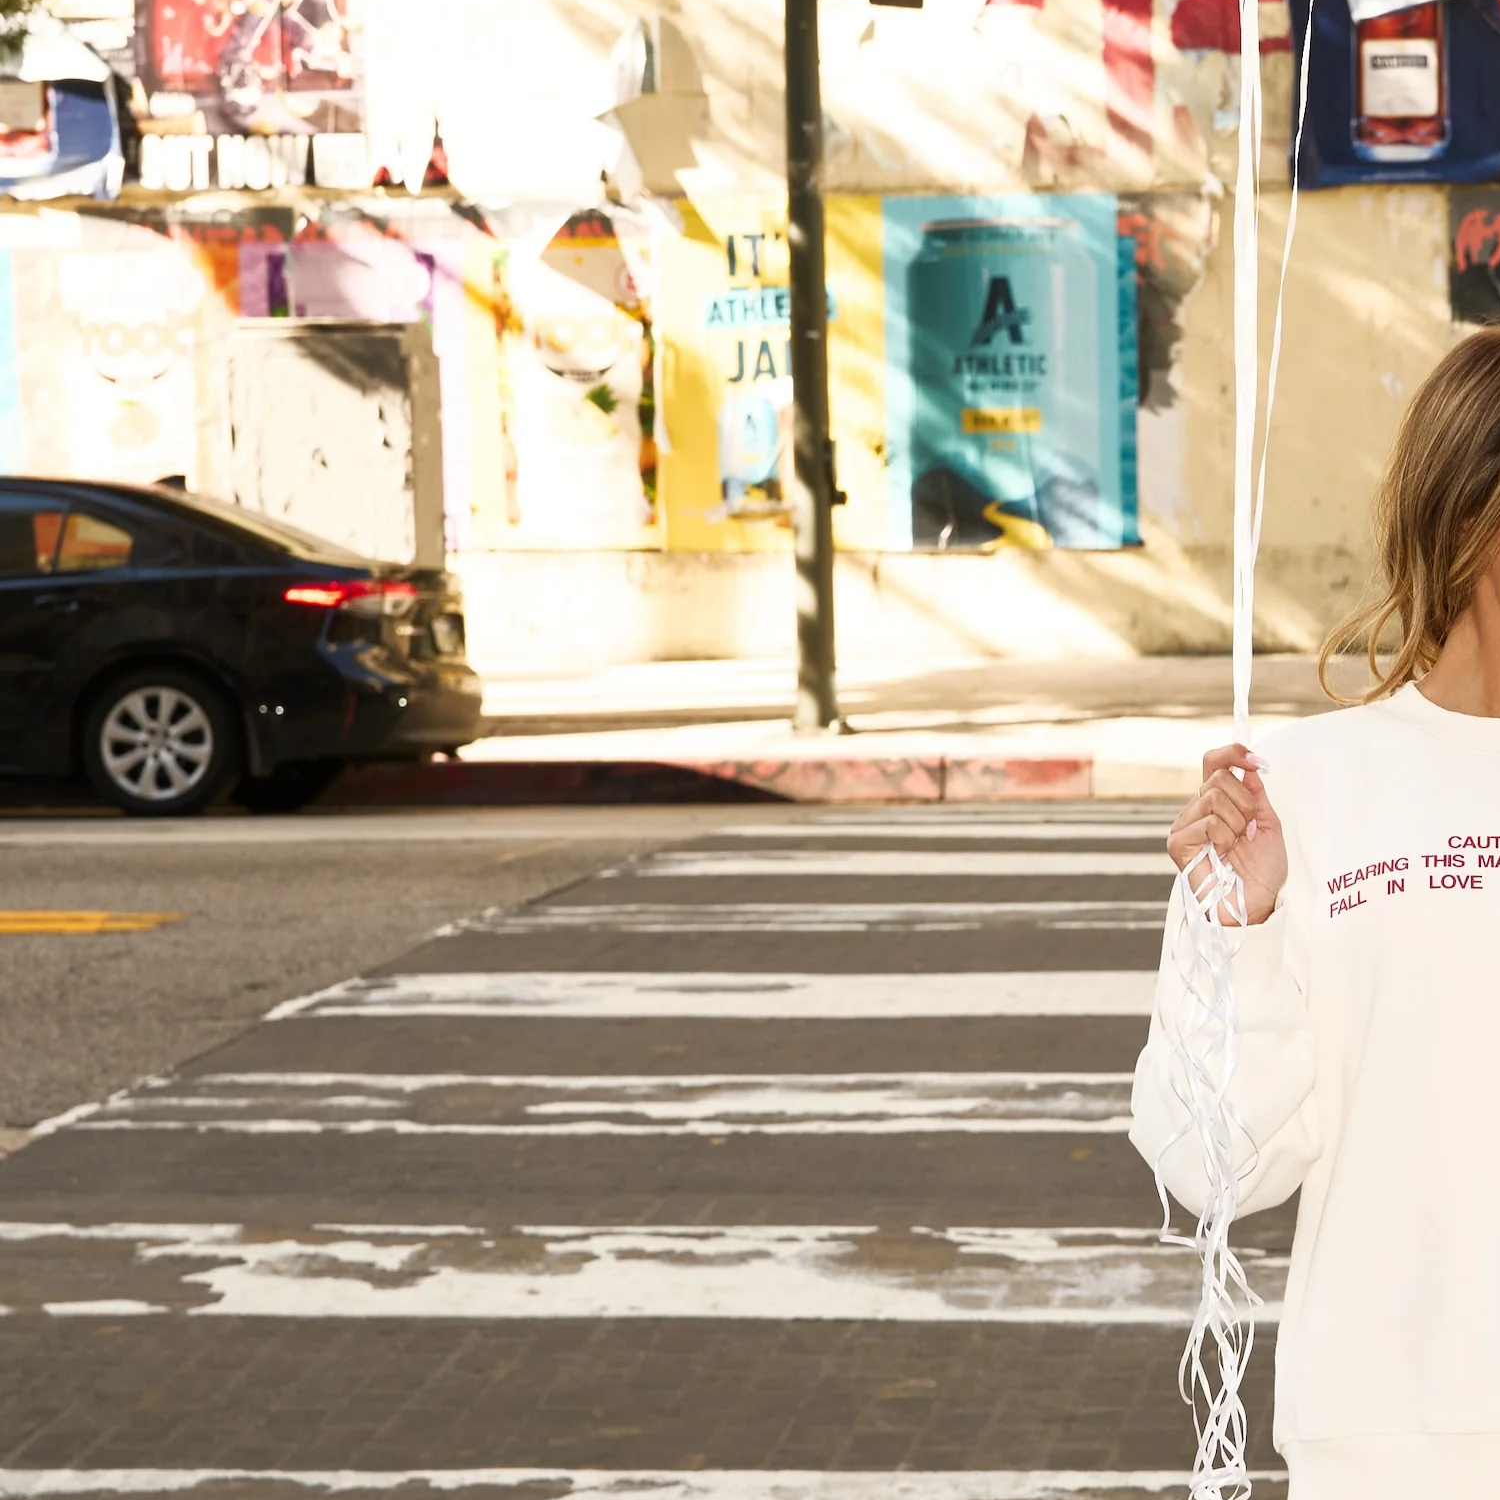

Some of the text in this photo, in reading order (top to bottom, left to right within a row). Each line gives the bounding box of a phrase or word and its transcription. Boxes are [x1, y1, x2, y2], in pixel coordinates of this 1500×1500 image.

[952, 352, 1048, 376] ATHLETIC
[1327, 857, 1409, 895] WEARING
[1421, 854, 1466, 868] THIS
[1329, 891, 1368, 918] FALL
[1386, 878, 1405, 895] IN
[1429, 875, 1483, 890] LOVE
